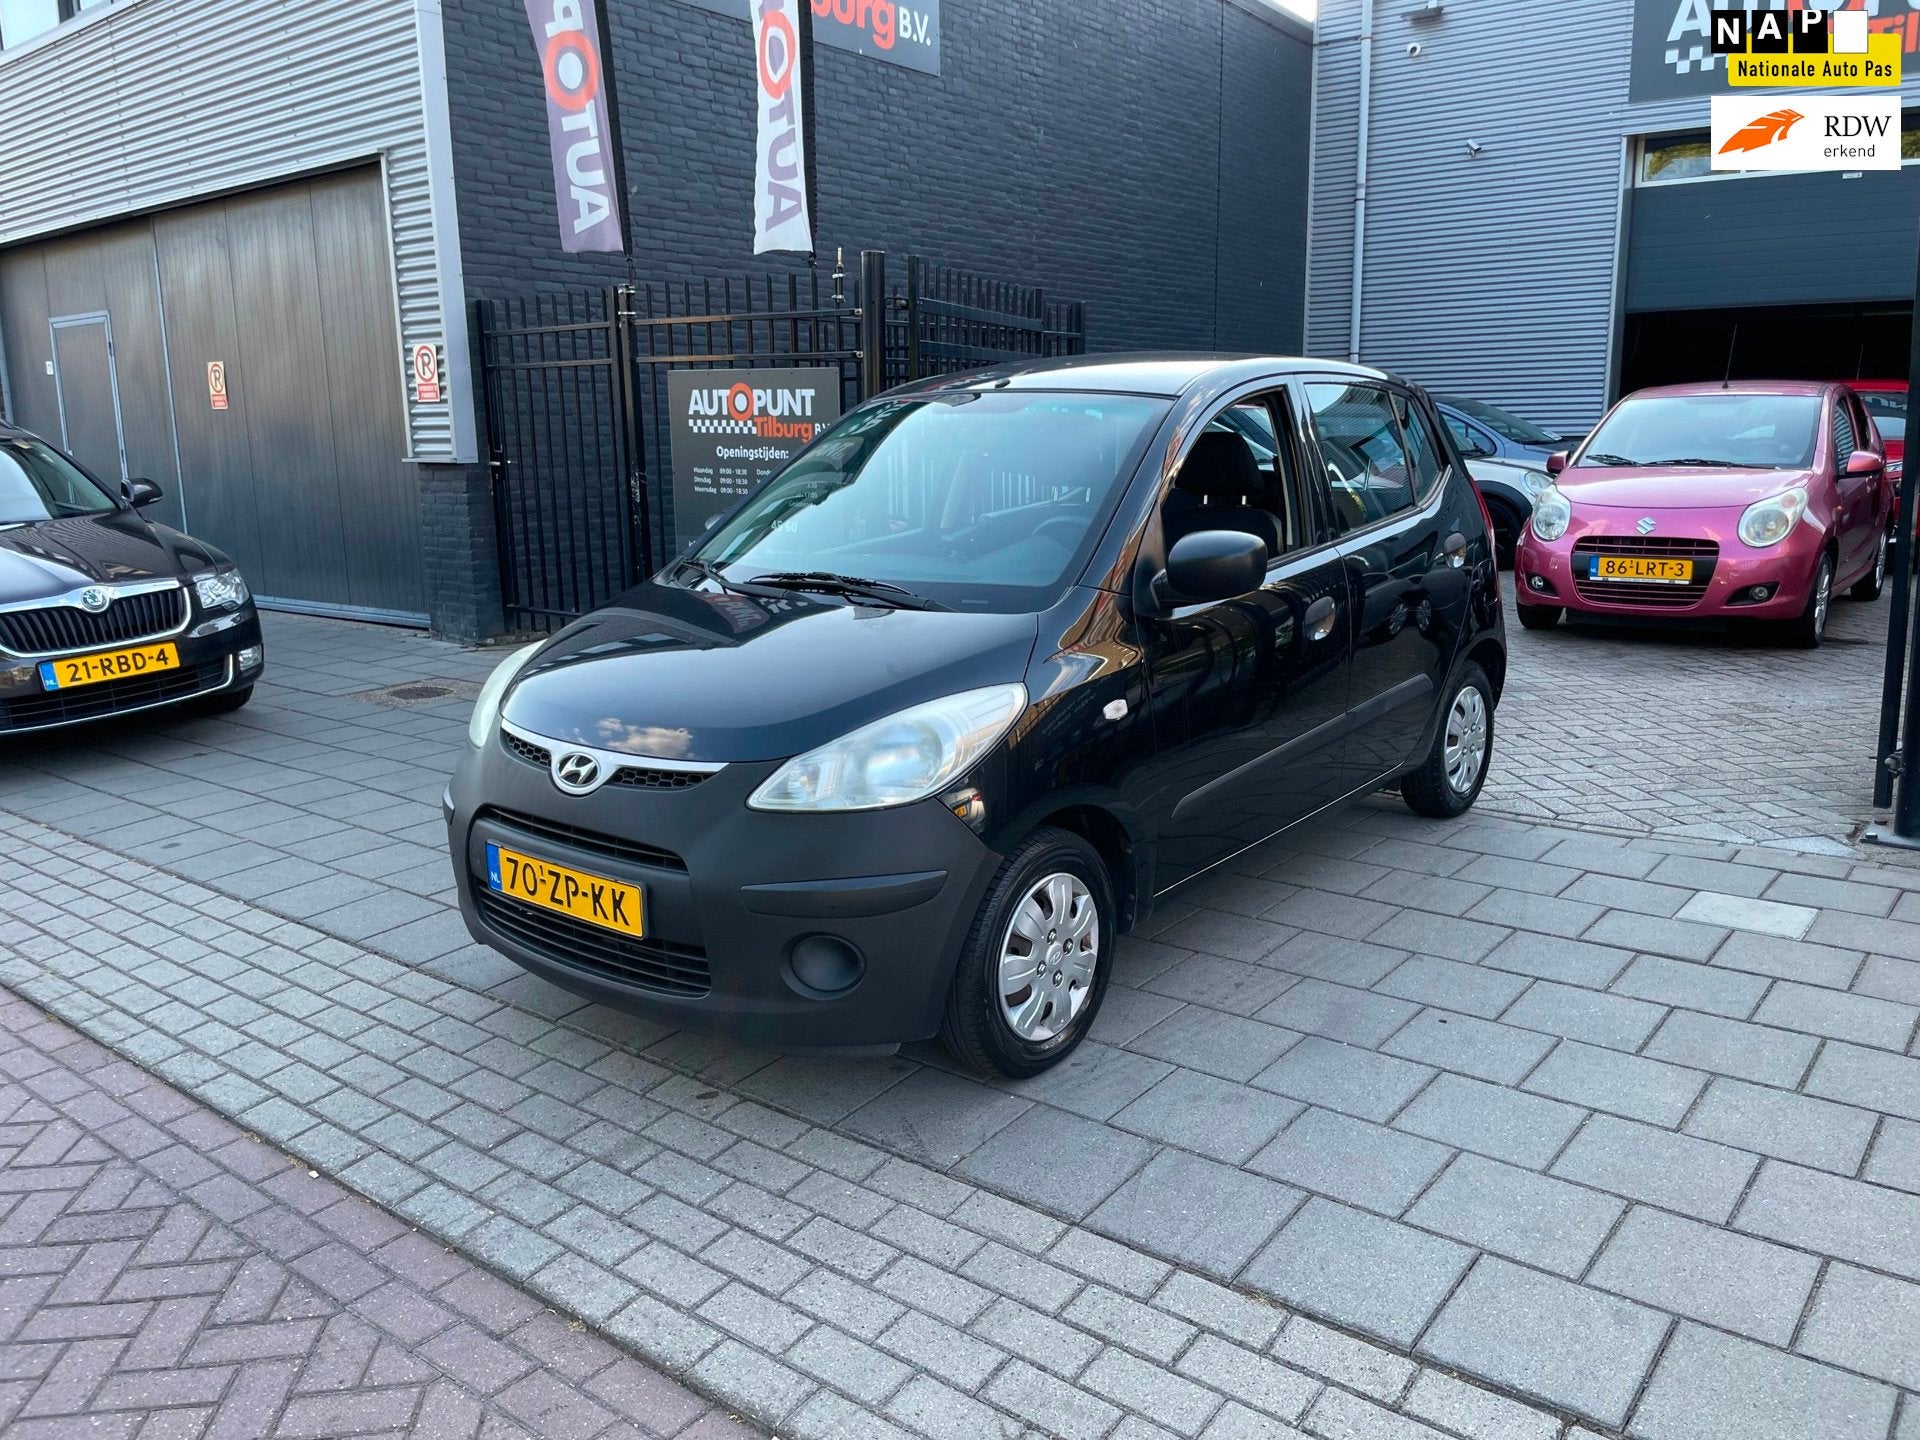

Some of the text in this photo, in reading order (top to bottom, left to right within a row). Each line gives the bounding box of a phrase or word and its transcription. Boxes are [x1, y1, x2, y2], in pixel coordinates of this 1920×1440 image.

[899, 6, 932, 47] B.V.
[688, 383, 816, 421] AUTOPUNT
[754, 416, 813, 443] Tilburg
[716, 446, 789, 461] Openingstijden:
[1606, 560, 1684, 577] 86-LRT-3
[66, 648, 169, 682] 21-RBD-4
[490, 857, 630, 926] NL 70-ZP-KK
